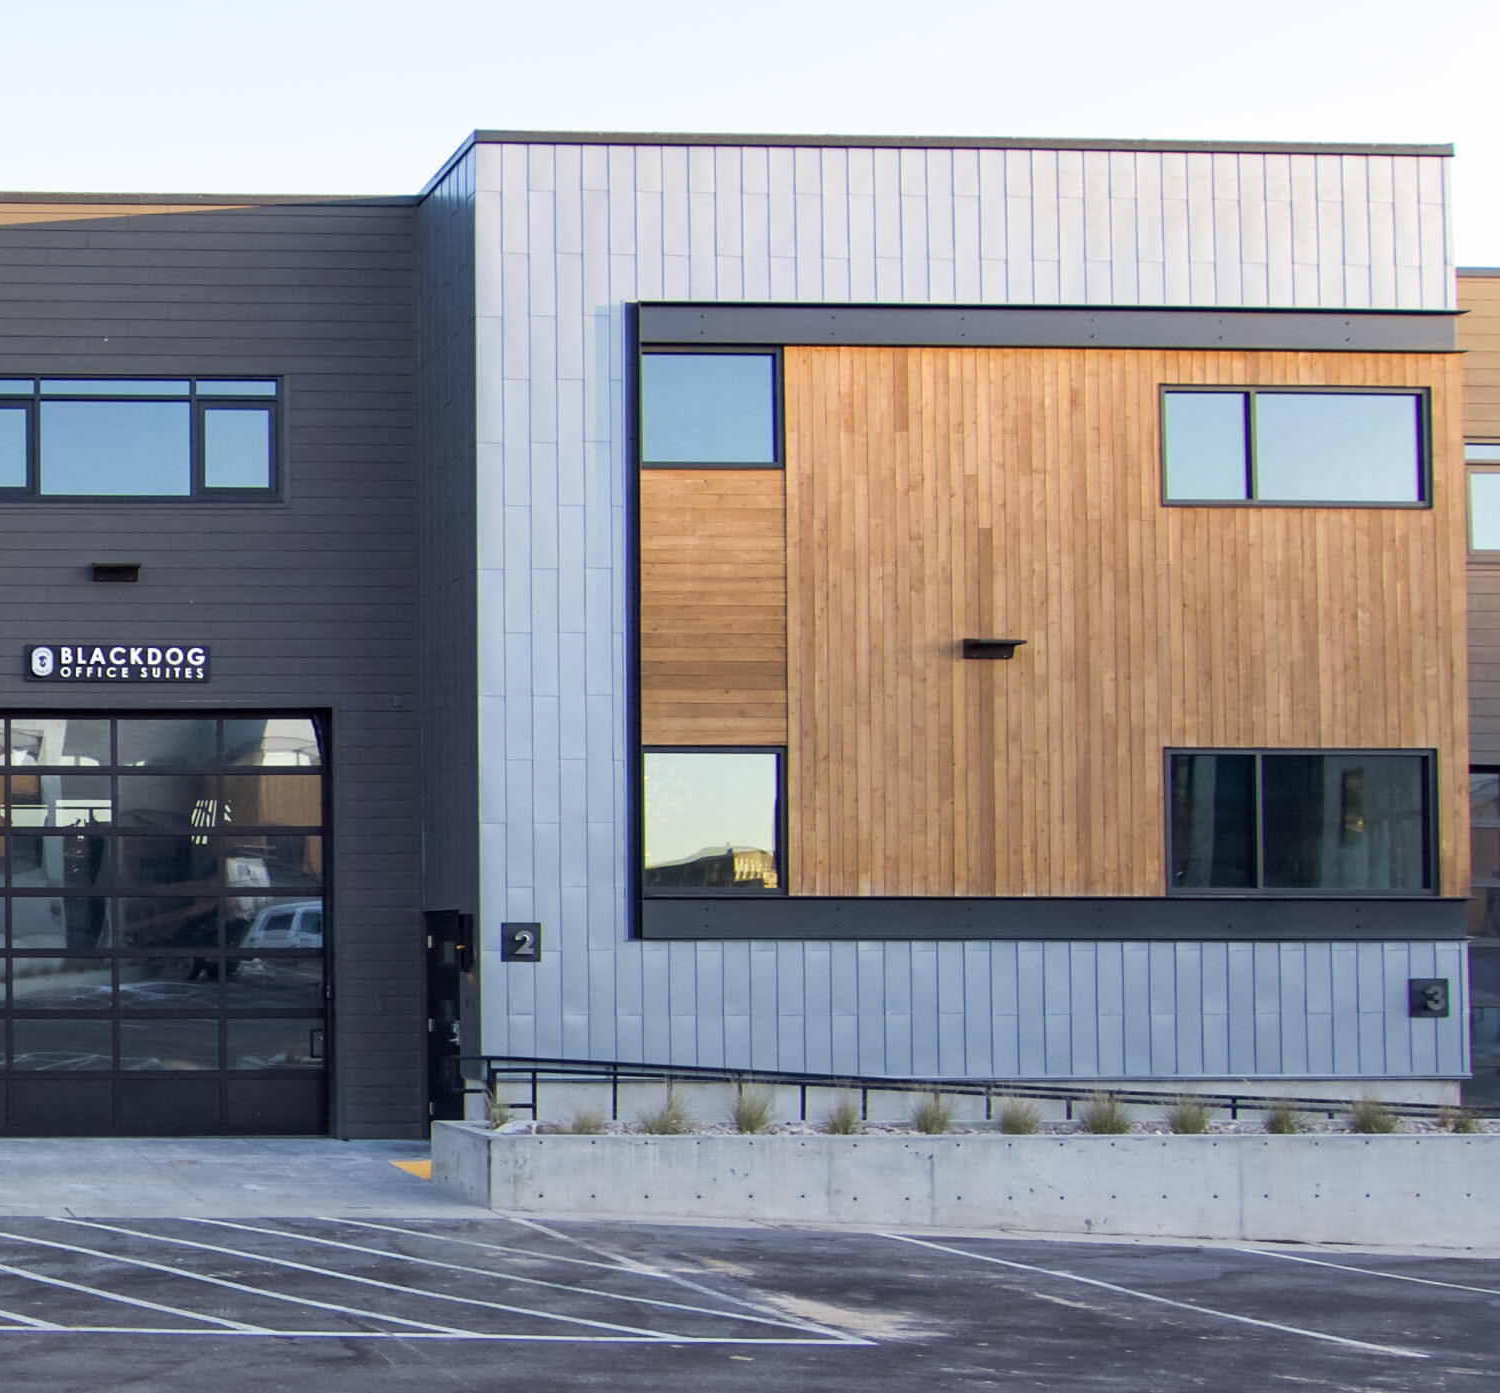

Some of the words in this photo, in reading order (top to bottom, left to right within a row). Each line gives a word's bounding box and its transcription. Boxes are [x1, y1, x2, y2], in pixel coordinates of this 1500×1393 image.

[60, 646, 206, 665] BLACKDOG
[60, 666, 129, 678] OFFICE
[140, 667, 204, 679] SUITES
[514, 930, 534, 955] 2
[1425, 985, 1446, 1010] 3
